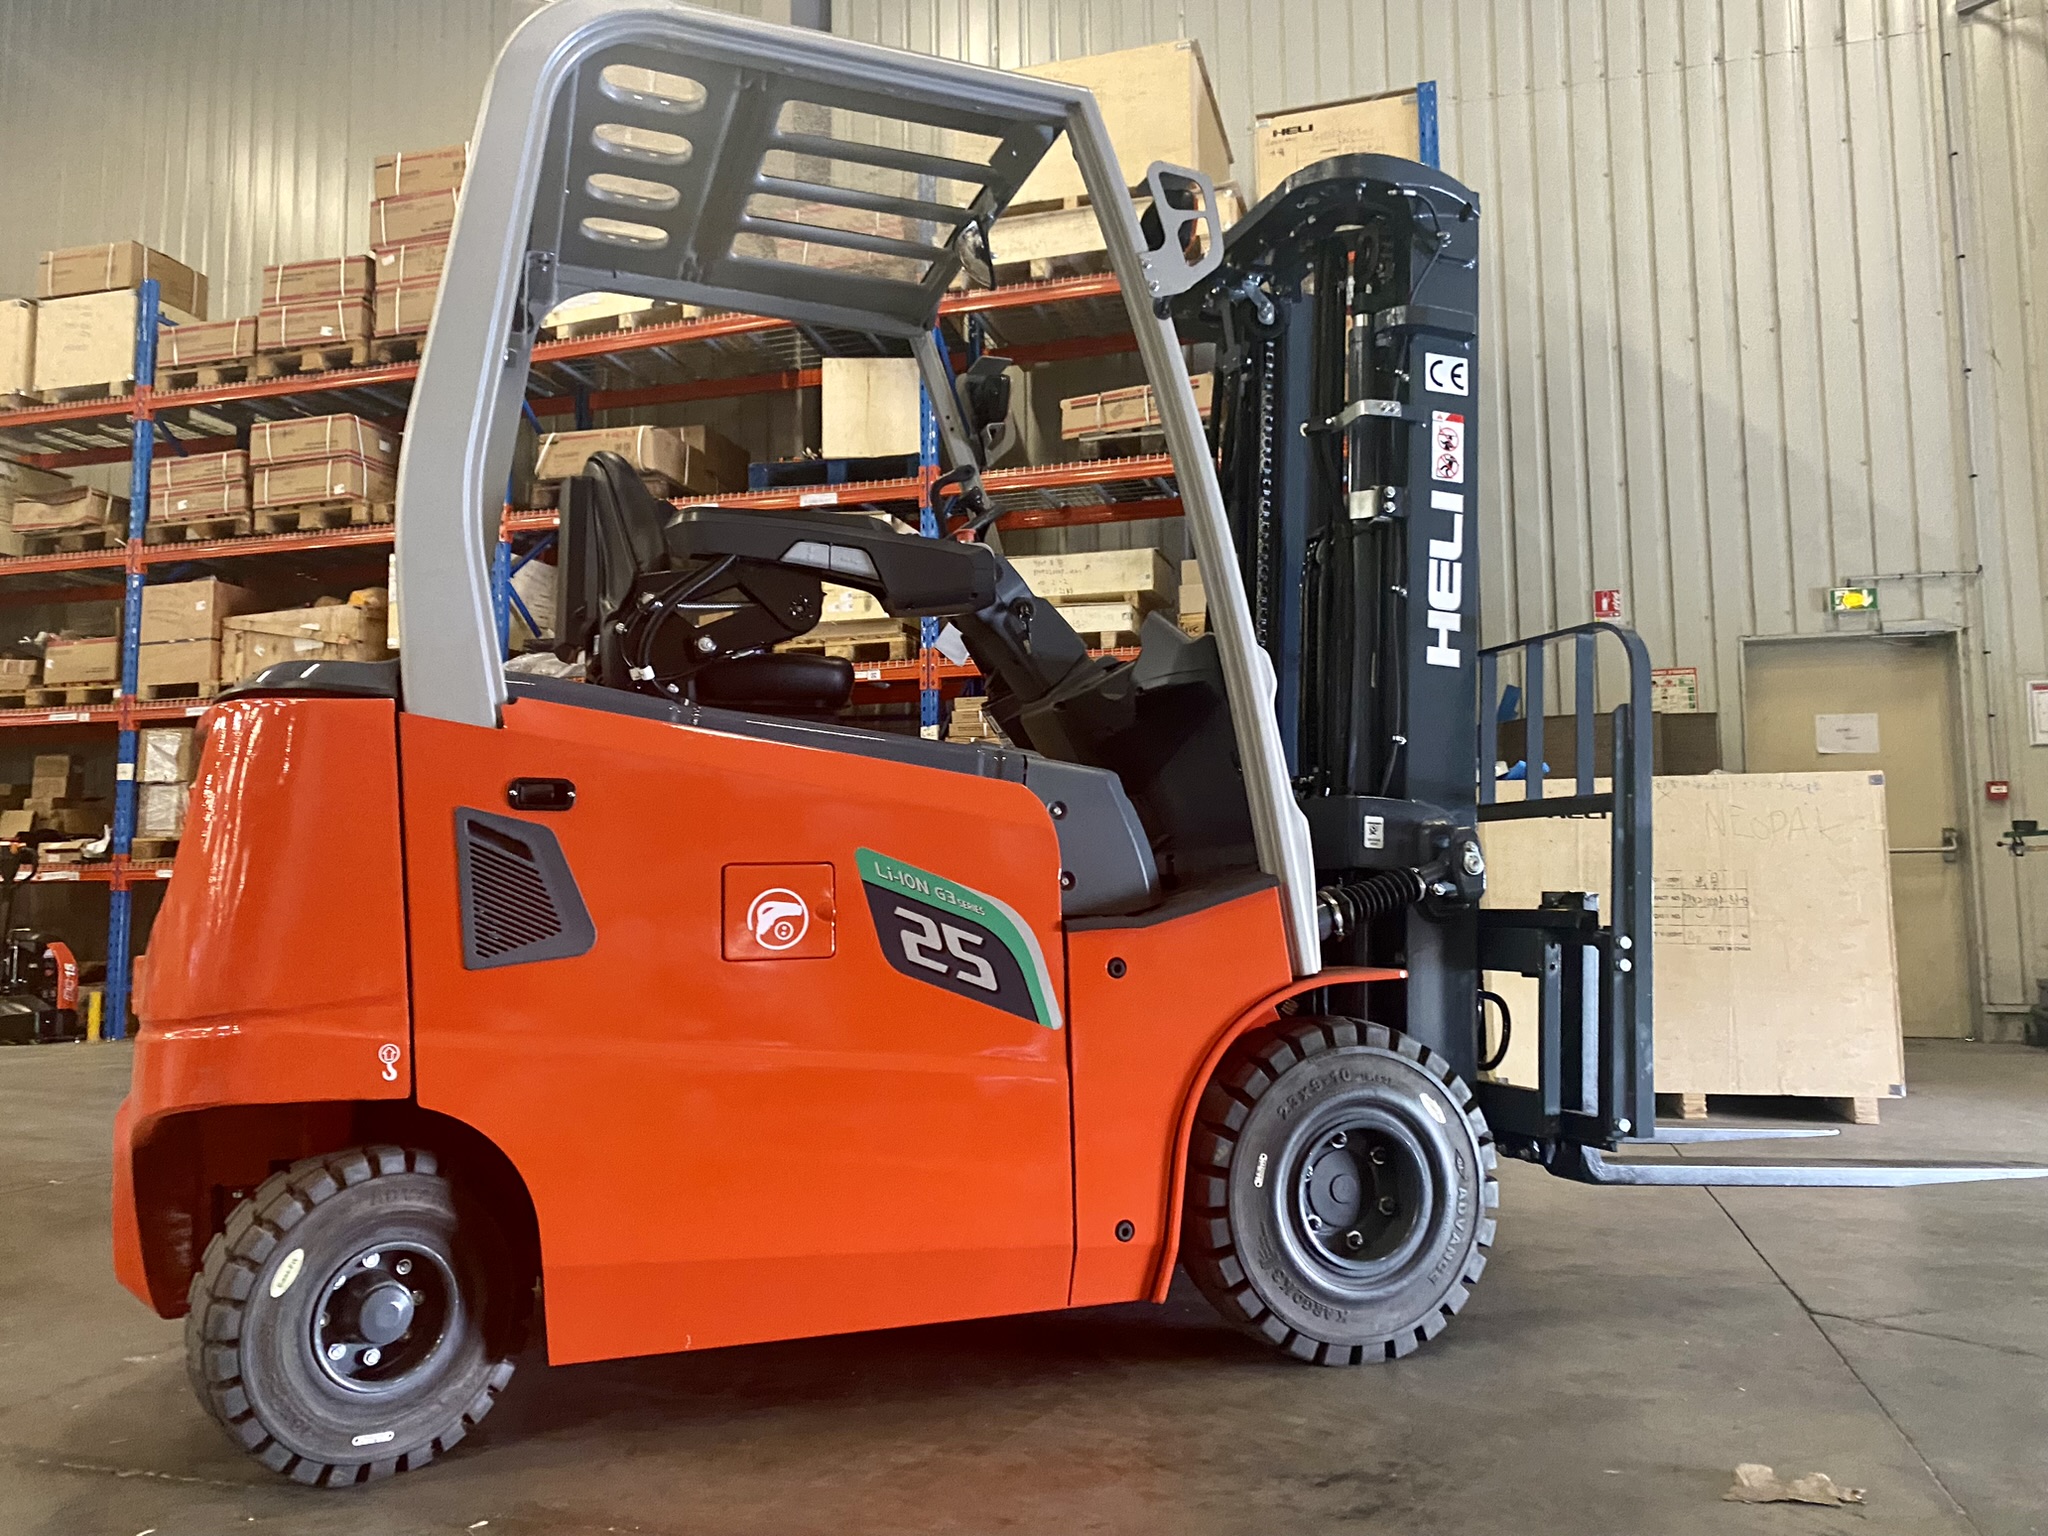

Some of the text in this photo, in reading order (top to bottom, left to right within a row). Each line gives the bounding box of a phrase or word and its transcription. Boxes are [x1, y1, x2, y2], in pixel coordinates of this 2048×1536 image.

[1272, 123, 1314, 138] HELI
[1430, 359, 1465, 391] CE
[1426, 489, 1465, 668] HELI
[874, 861, 930, 895] Li-ION
[893, 906, 998, 992] 25
[1427, 1186, 1469, 1286] ADVANCE
